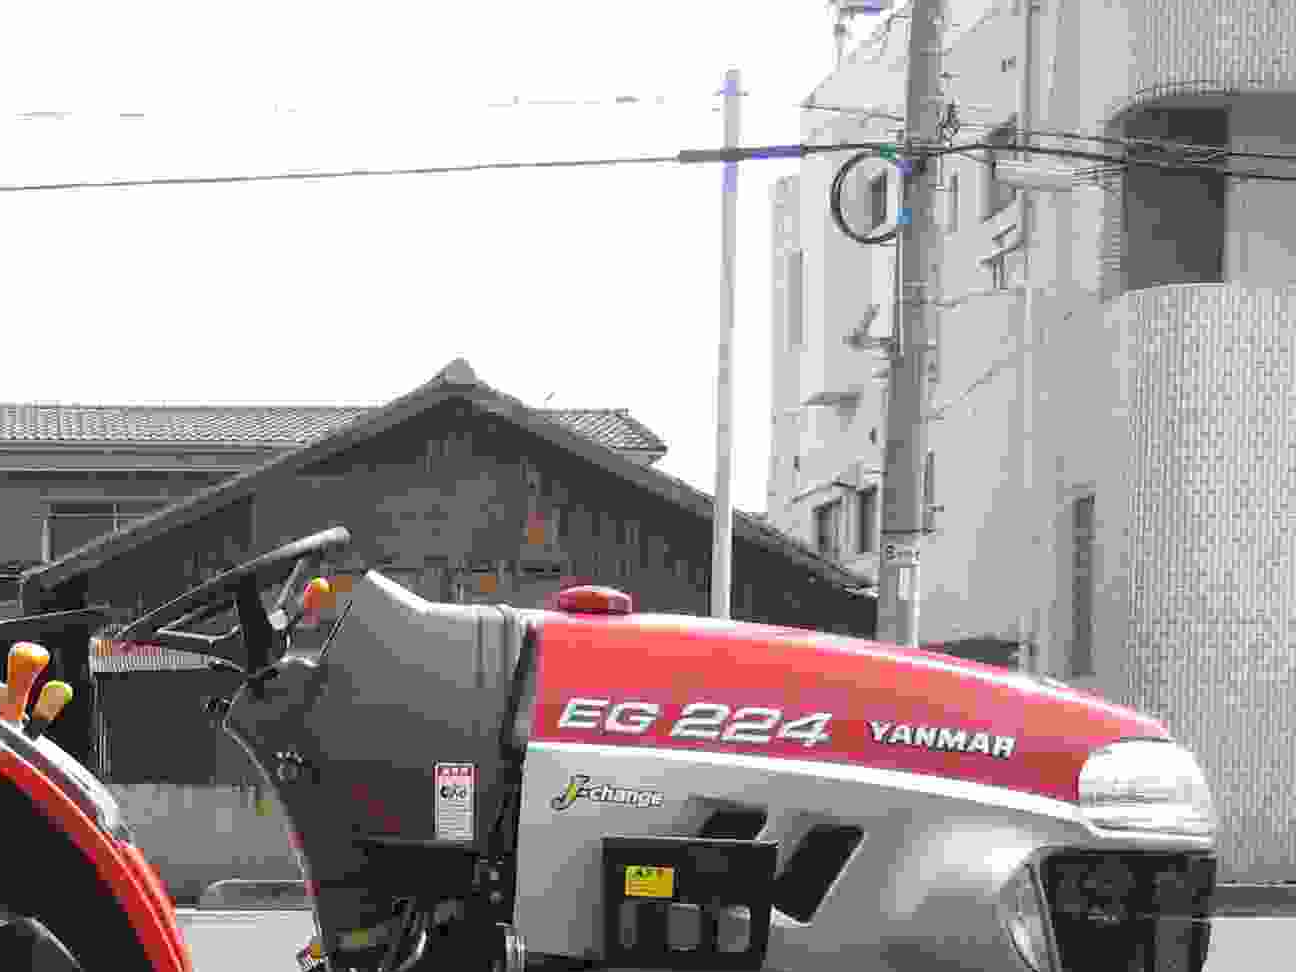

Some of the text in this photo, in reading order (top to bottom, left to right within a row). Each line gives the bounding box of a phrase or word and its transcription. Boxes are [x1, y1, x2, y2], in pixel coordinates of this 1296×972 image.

[557, 696, 833, 747] EG 224
[866, 719, 1017, 759] YANMAR
